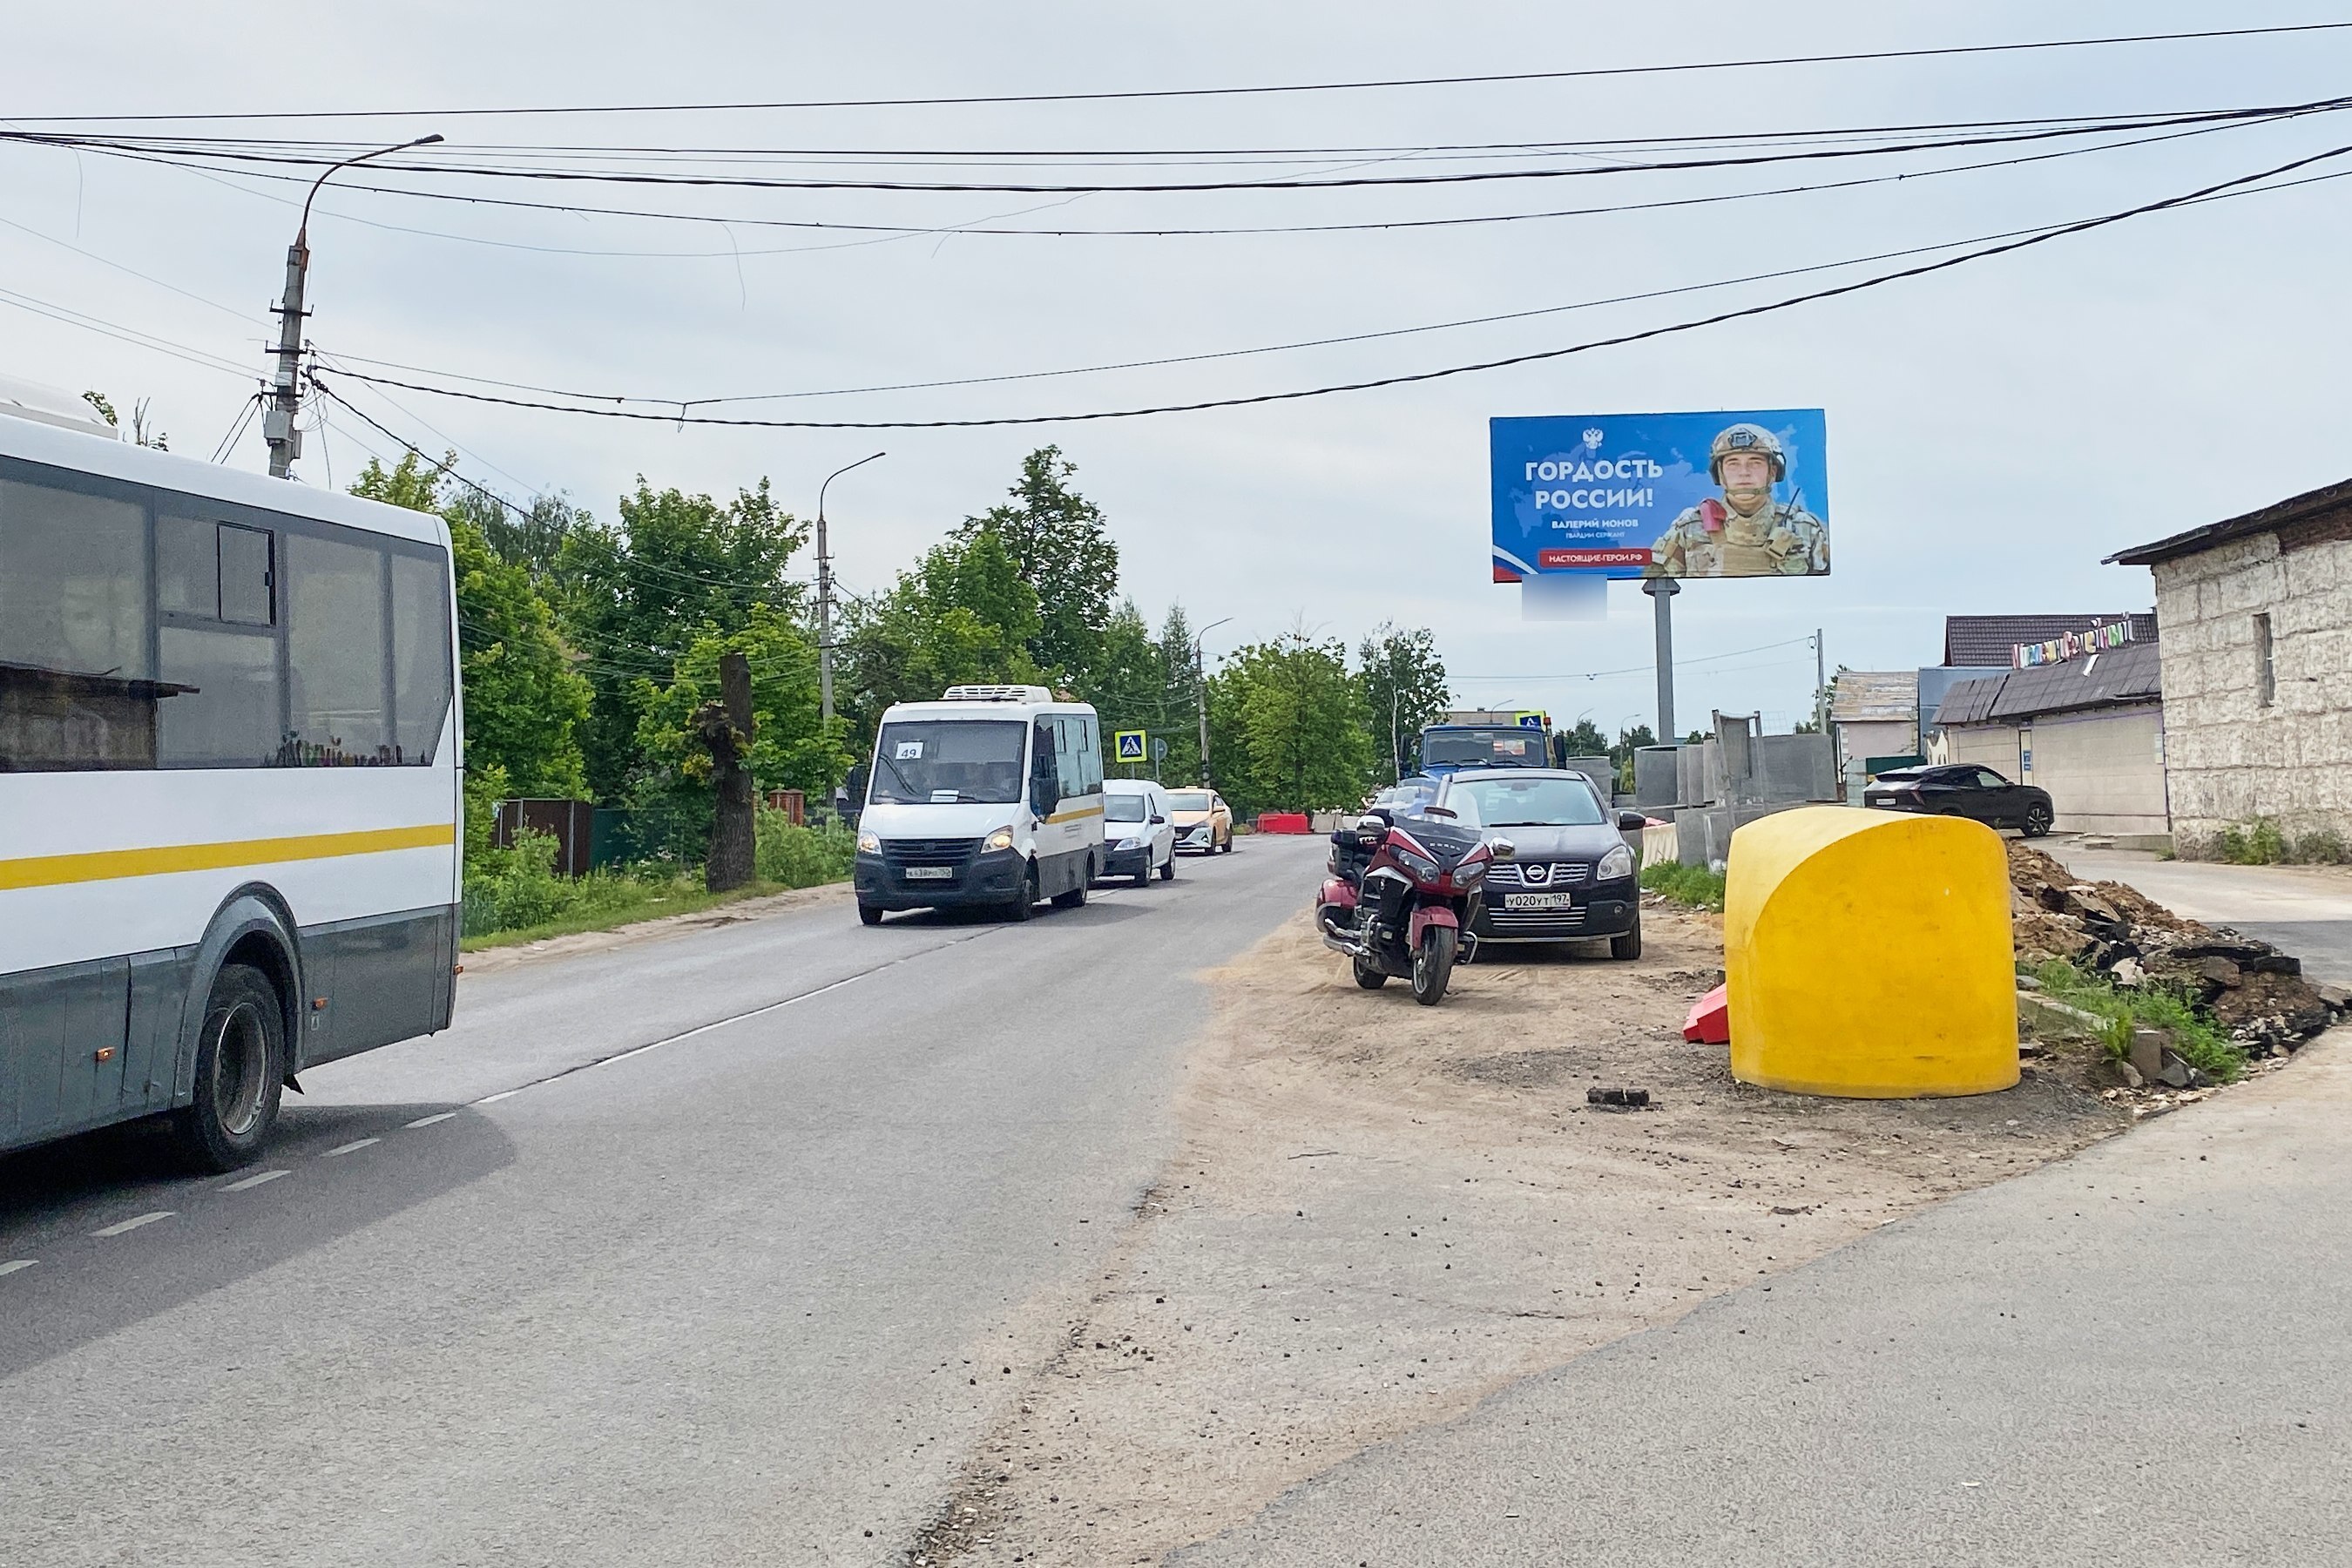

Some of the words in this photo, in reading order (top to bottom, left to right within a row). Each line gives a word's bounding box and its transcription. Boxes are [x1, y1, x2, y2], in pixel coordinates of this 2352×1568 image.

[1525, 459, 1663, 483] ГОРДОСТЬ
[1535, 488, 1653, 510] РОССИИ!
[1551, 518, 1599, 529] ВАЛЕРИЙ
[1602, 519, 1639, 528] ИОНОВ
[1549, 553, 1643, 564] НАСТОЯЩИЕ-ГЕРОИ.РФ
[902, 748, 916, 759] 49
